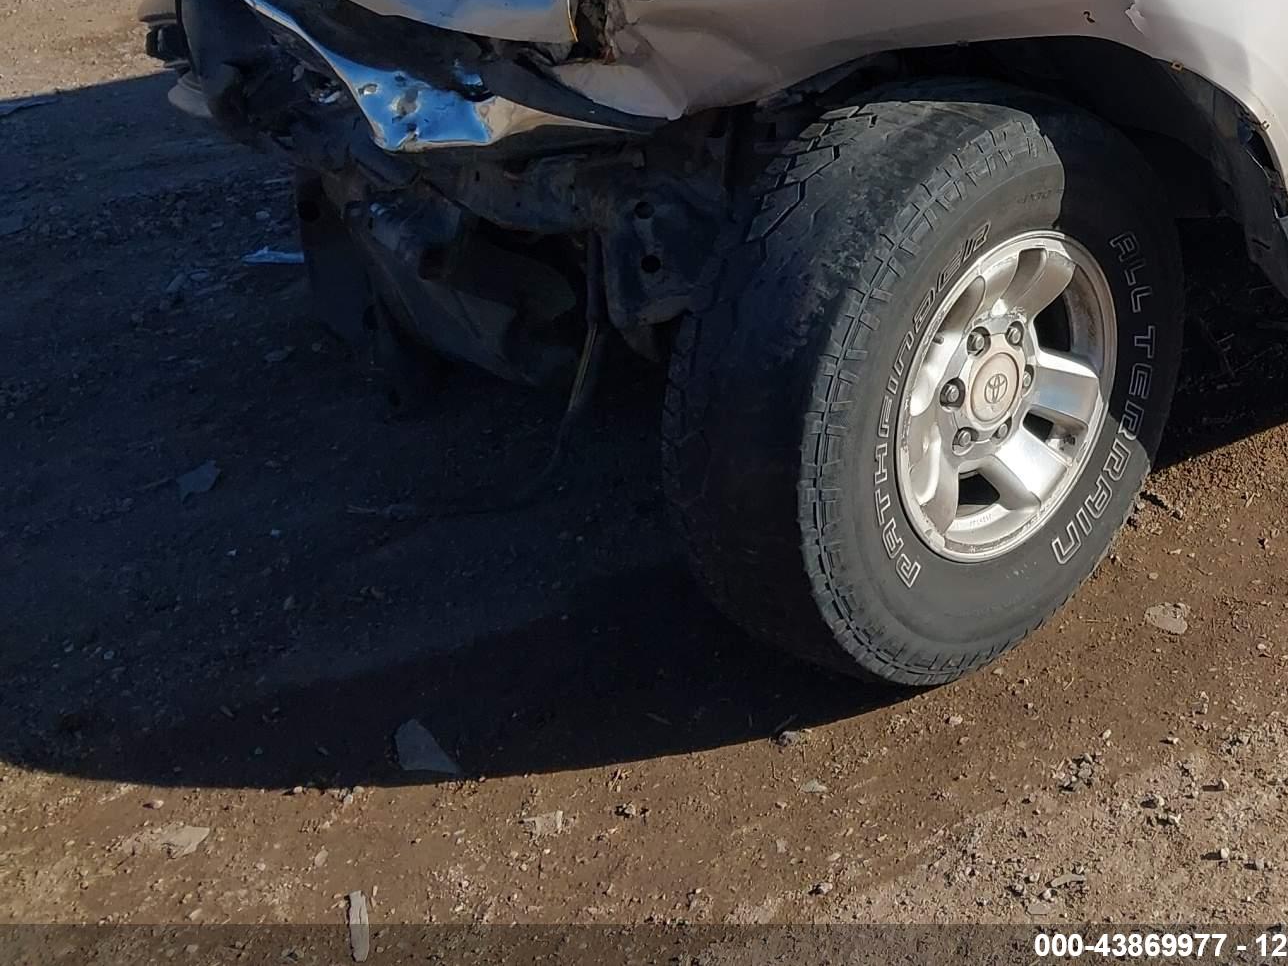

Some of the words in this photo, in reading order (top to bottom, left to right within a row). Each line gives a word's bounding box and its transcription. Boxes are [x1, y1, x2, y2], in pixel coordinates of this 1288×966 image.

[1108, 231, 1154, 314] ALL
[873, 221, 992, 589] PATHFINDER
[1050, 324, 1157, 566] TERRAIN
